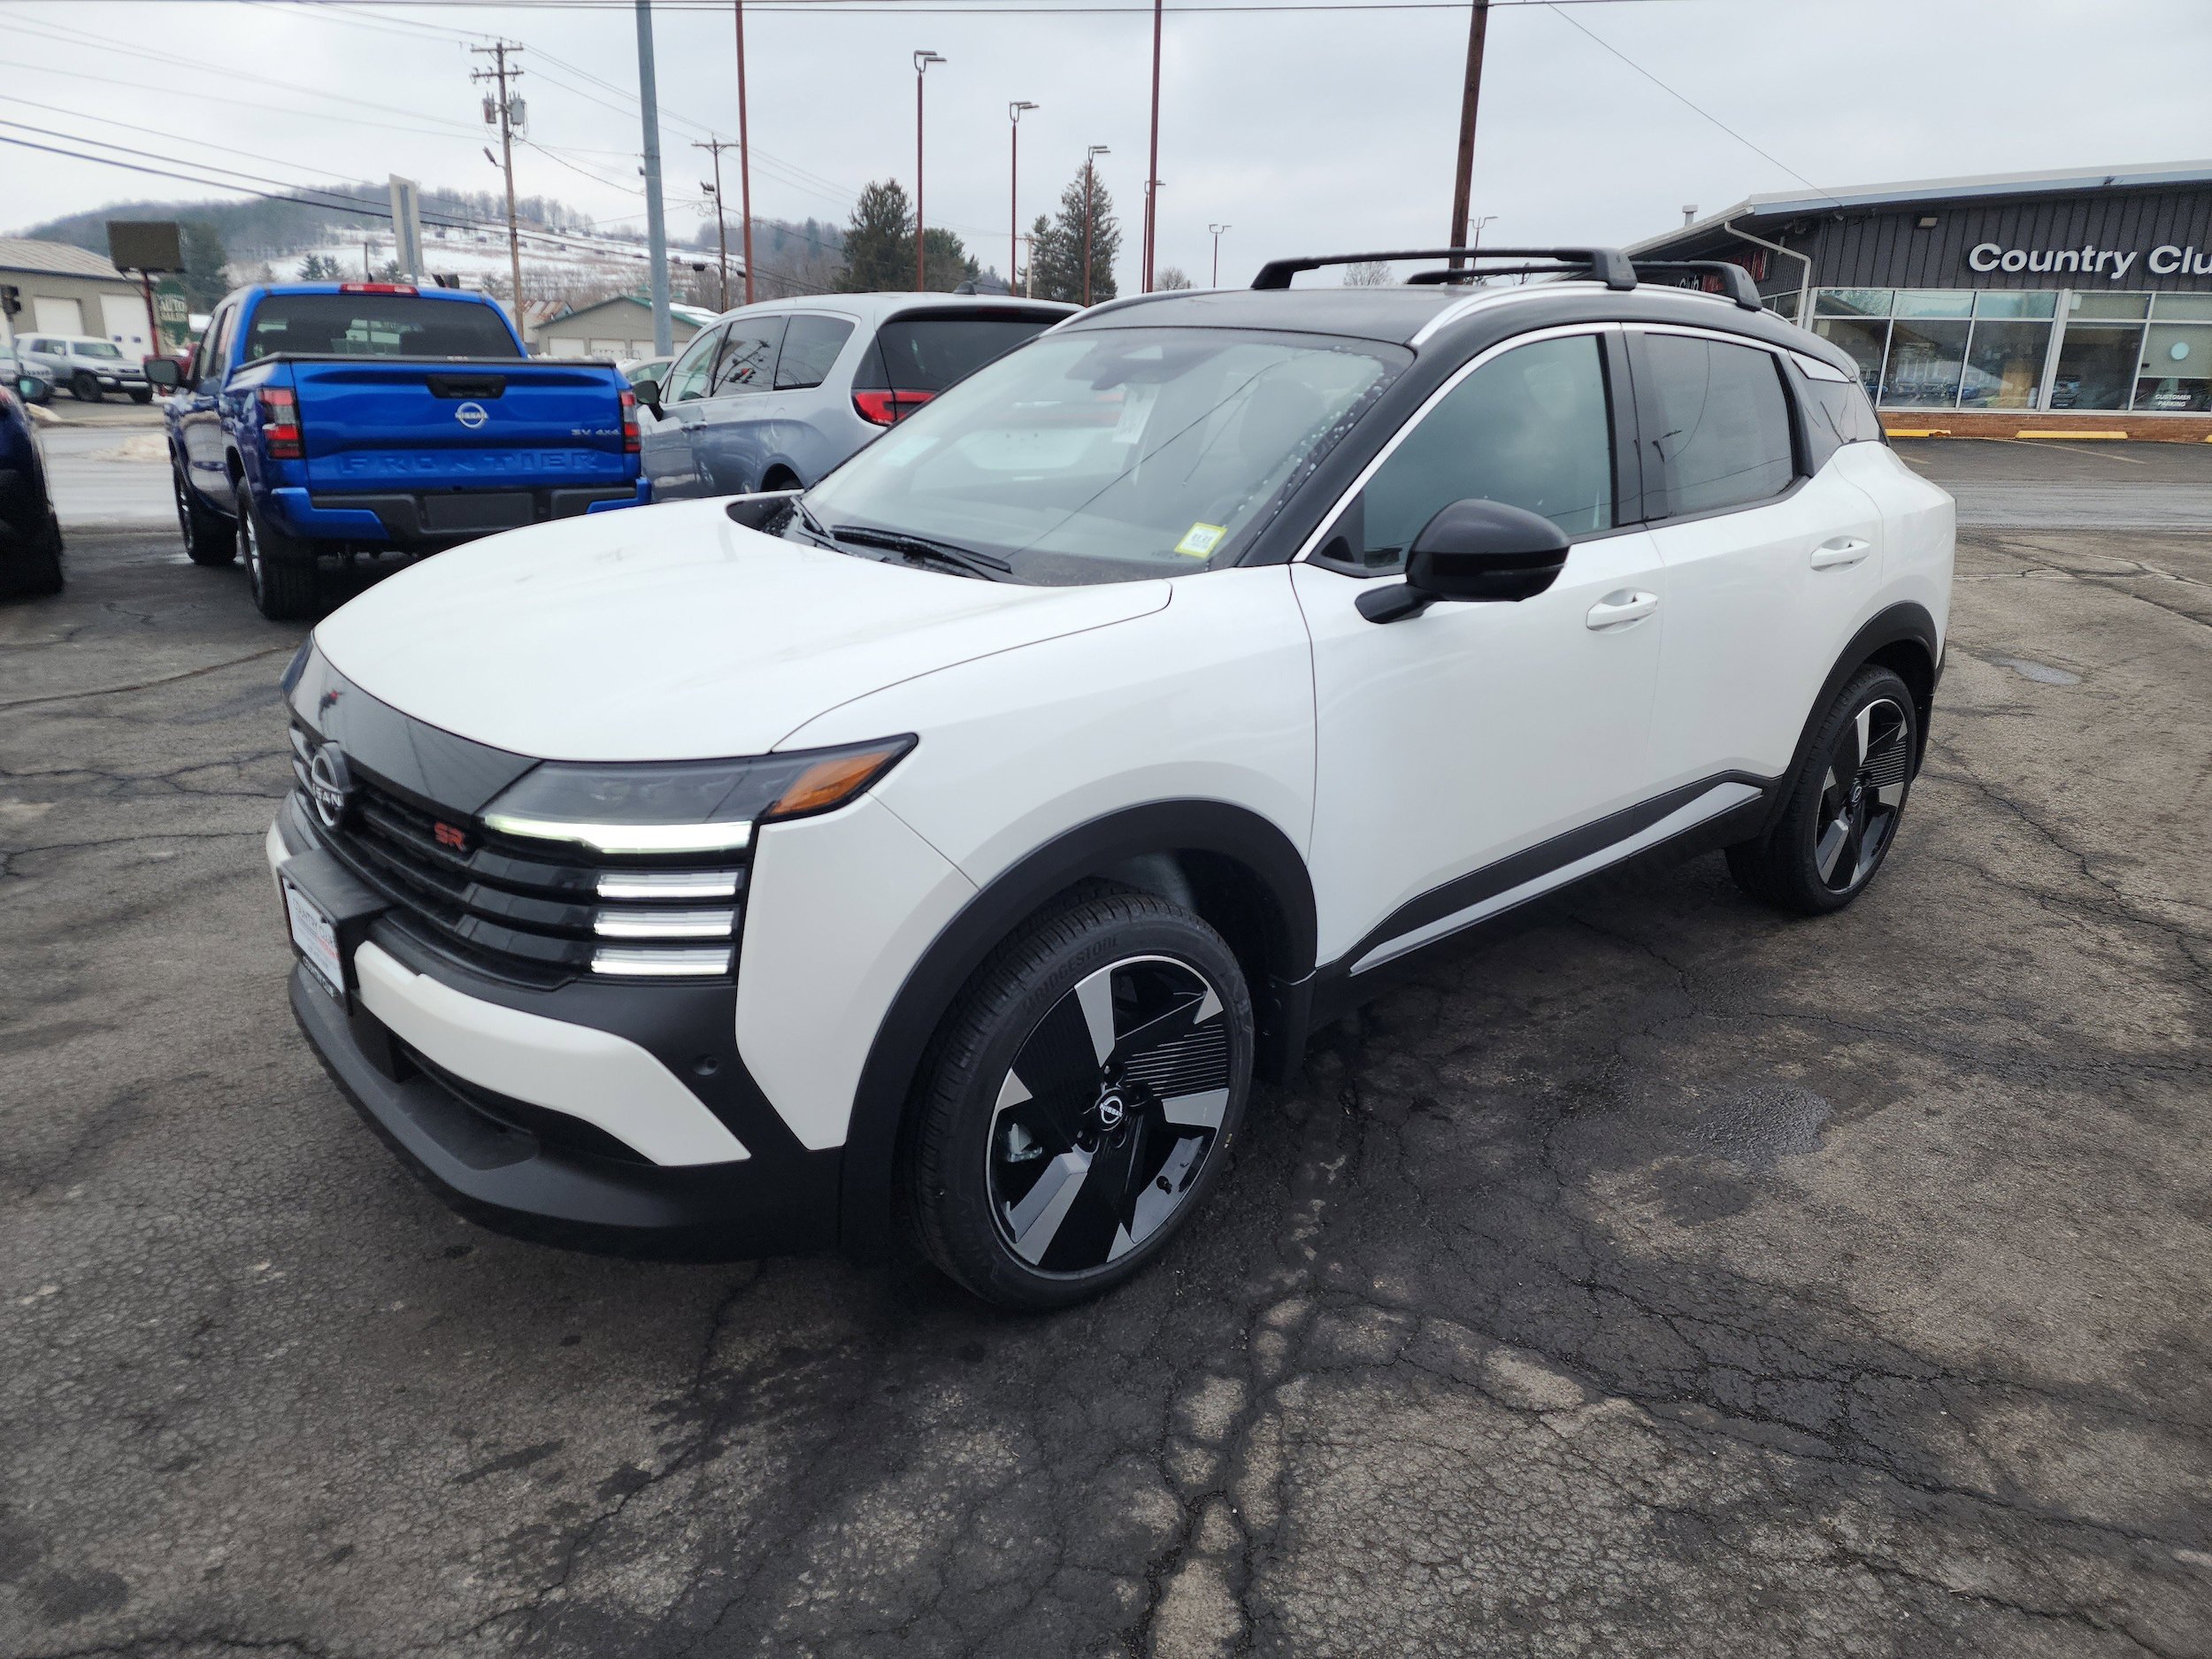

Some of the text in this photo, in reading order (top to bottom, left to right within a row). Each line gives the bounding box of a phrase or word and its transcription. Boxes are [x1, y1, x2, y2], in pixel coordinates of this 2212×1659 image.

[1969, 242, 2212, 279] Country Clu
[455, 411, 488, 420] NISSAN
[341, 451, 598, 474] FRONTIER
[434, 821, 466, 851] SR
[1100, 1102, 1123, 1118] NISSAN
